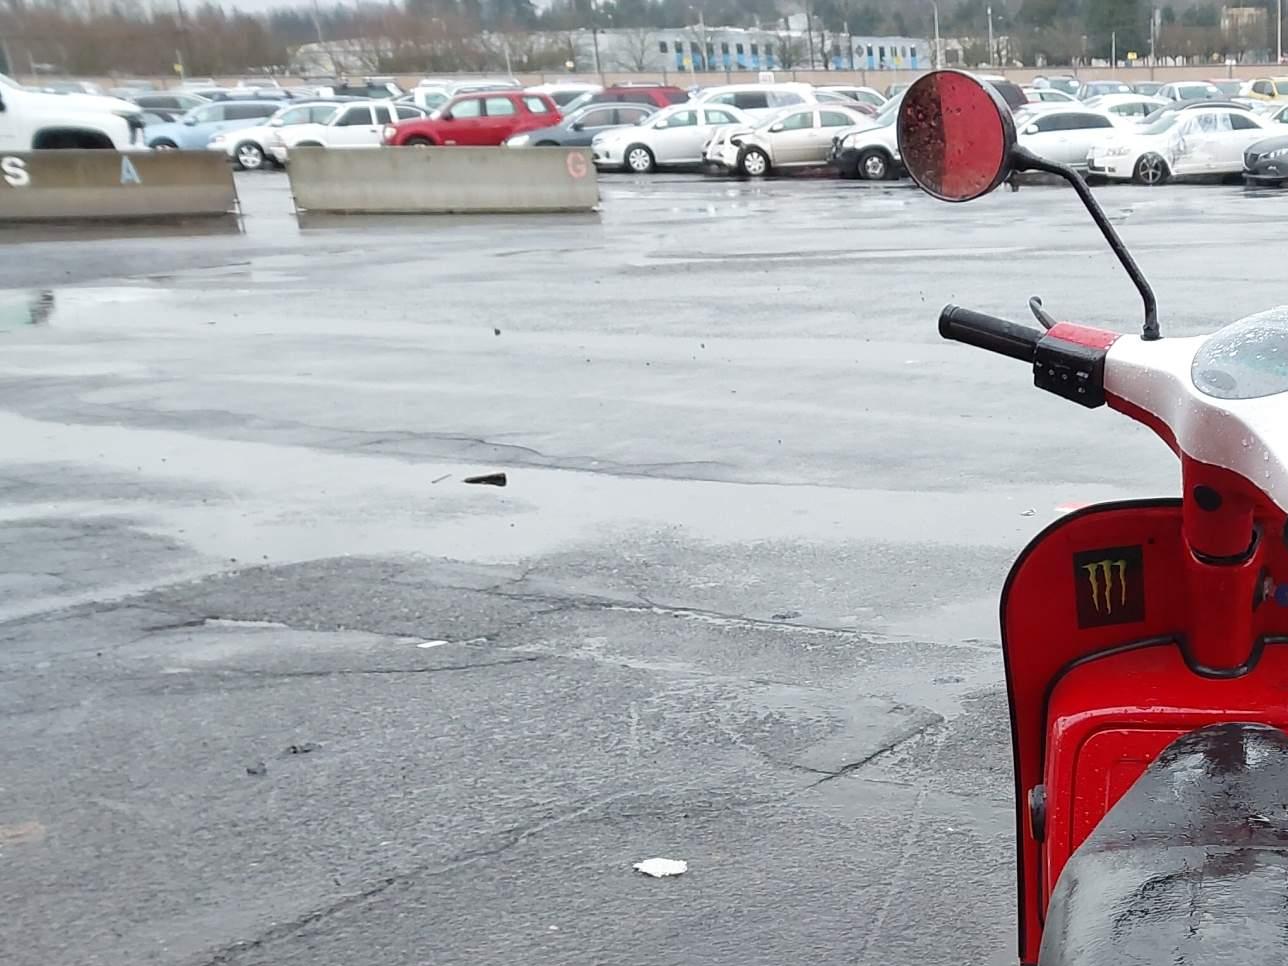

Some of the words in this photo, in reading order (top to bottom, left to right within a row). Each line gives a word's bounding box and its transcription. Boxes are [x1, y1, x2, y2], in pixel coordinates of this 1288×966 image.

[0, 155, 31, 187] S
[119, 155, 142, 185] A
[566, 151, 587, 178] G
